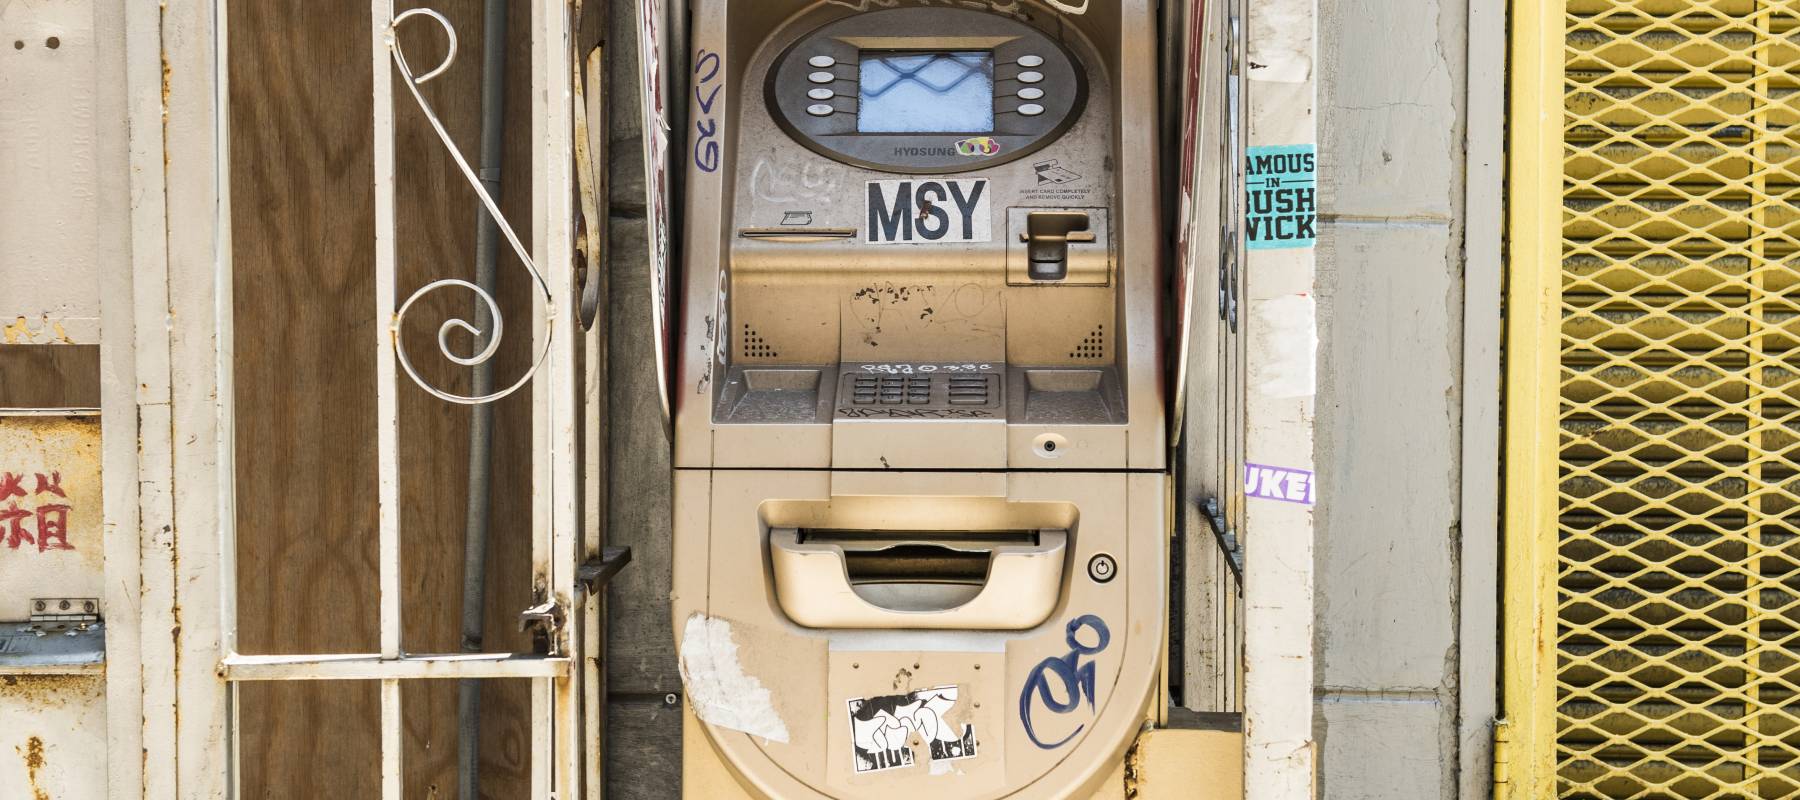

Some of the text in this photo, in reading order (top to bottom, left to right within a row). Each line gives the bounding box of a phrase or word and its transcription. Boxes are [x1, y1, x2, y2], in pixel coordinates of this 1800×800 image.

[894, 147, 956, 156] HYOSUNG
[1265, 178, 1281, 188] IN
[1246, 188, 1315, 215] USH
[868, 180, 987, 242] MSY
